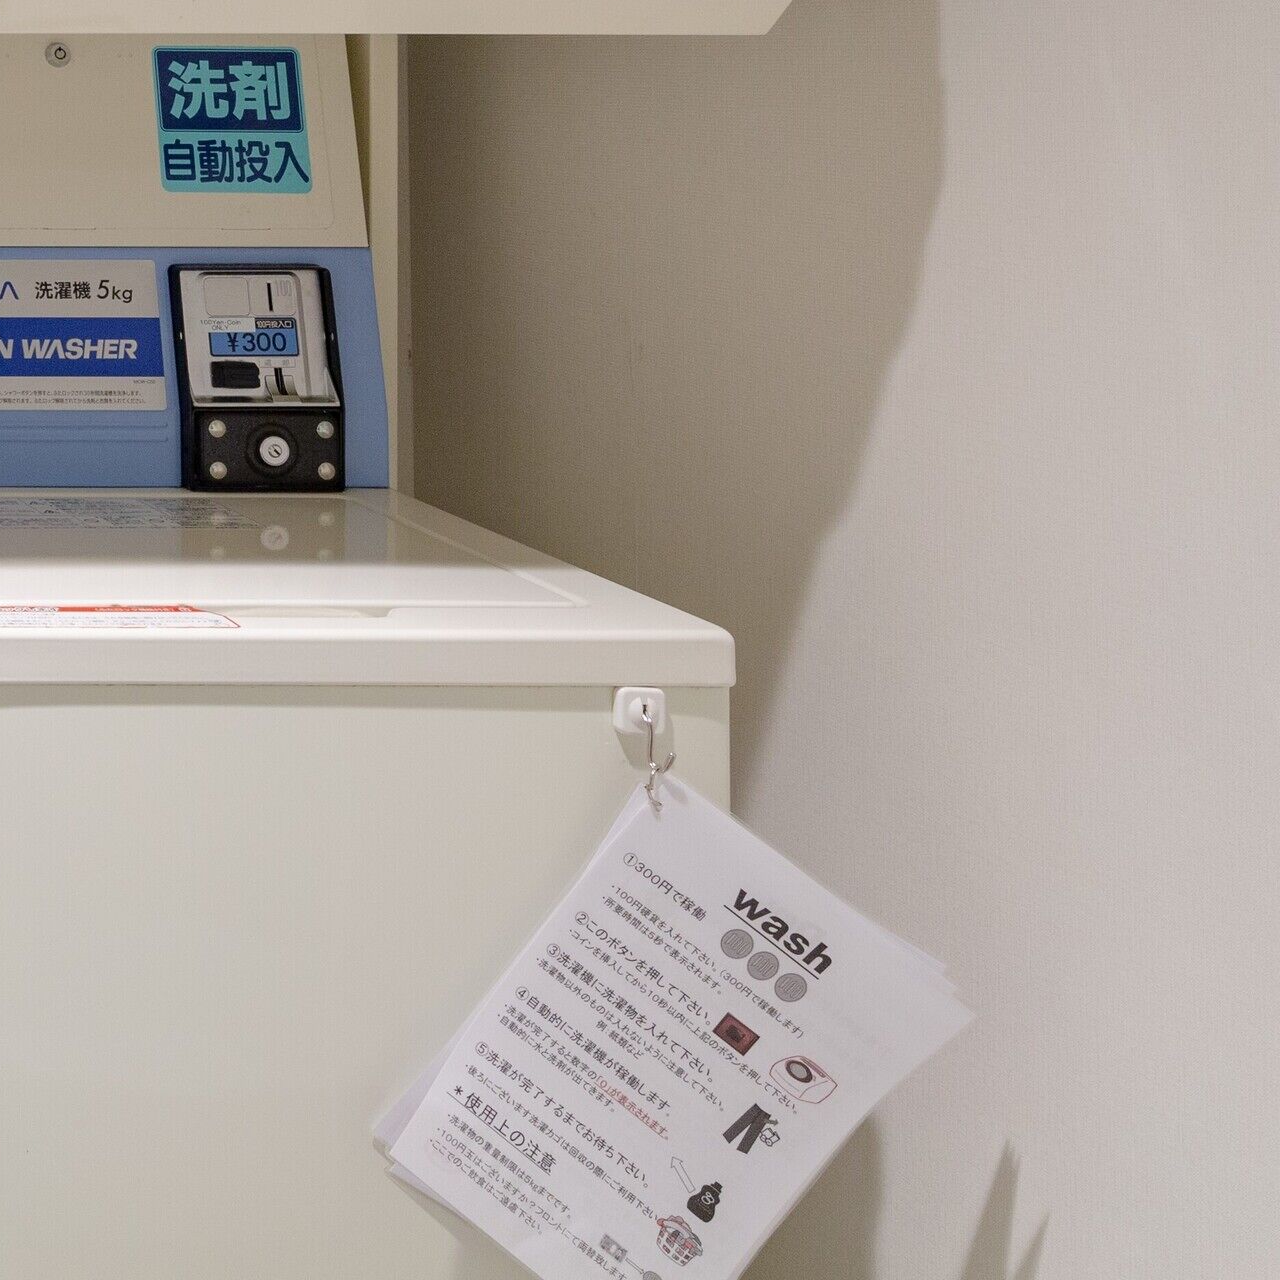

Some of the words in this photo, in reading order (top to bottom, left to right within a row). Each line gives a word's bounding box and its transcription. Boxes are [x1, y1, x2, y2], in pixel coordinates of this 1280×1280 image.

[167, 60, 292, 121] 洗剤
[162, 139, 309, 184] 自動投入
[34, 280, 91, 300] 洗濯機
[96, 279, 133, 303] 5kg
[21, 339, 138, 360] WASHER
[226, 332, 287, 352] ¥300
[734, 890, 831, 973] wash
